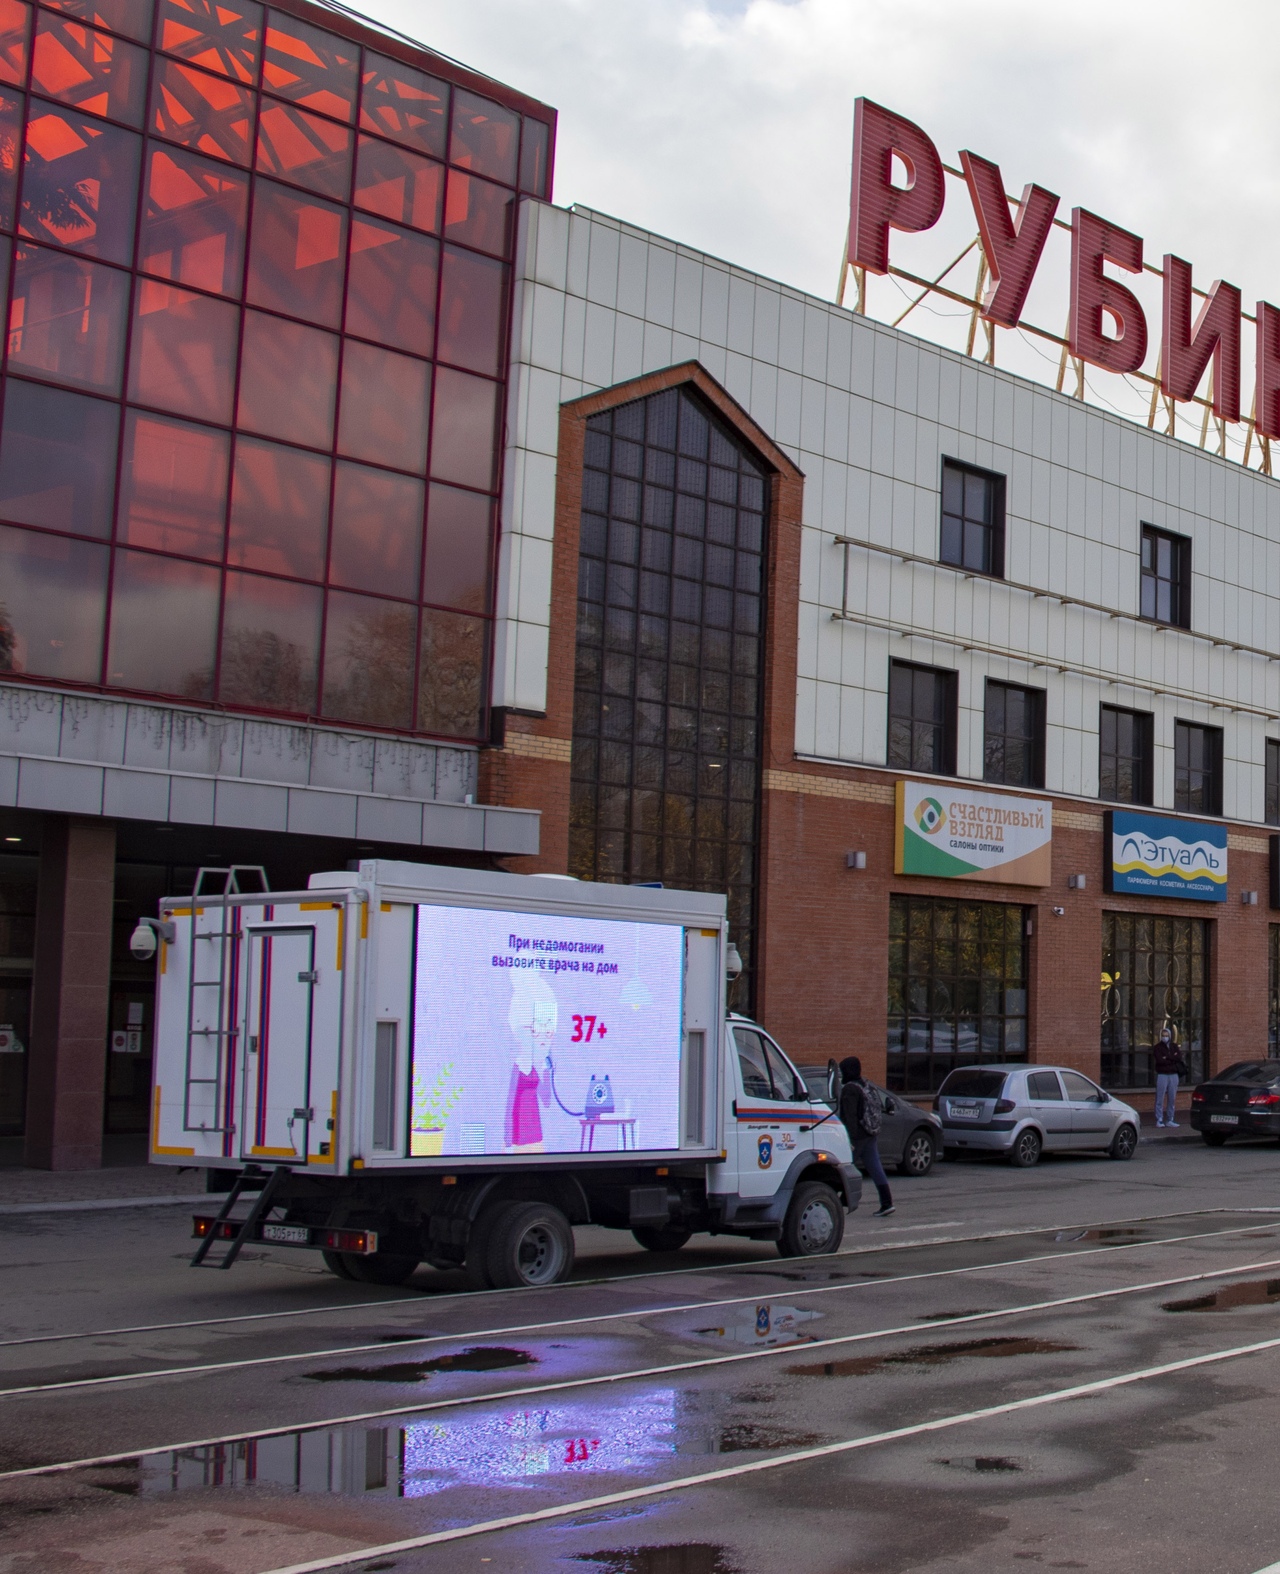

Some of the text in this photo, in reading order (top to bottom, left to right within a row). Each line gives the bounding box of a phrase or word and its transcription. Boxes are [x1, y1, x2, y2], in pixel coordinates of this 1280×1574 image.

[950, 839, 1004, 853] салоны оптики
[1127, 876, 1214, 892] ПАРФЮМЕРИЯ КОСМЕТИКА АКСЕССУАРЫ
[509, 934, 604, 953] При недомогании
[492, 955, 618, 975] вызовите врача на дом
[571, 1014, 608, 1043] 37+
[782, 1133, 791, 1142] 30
